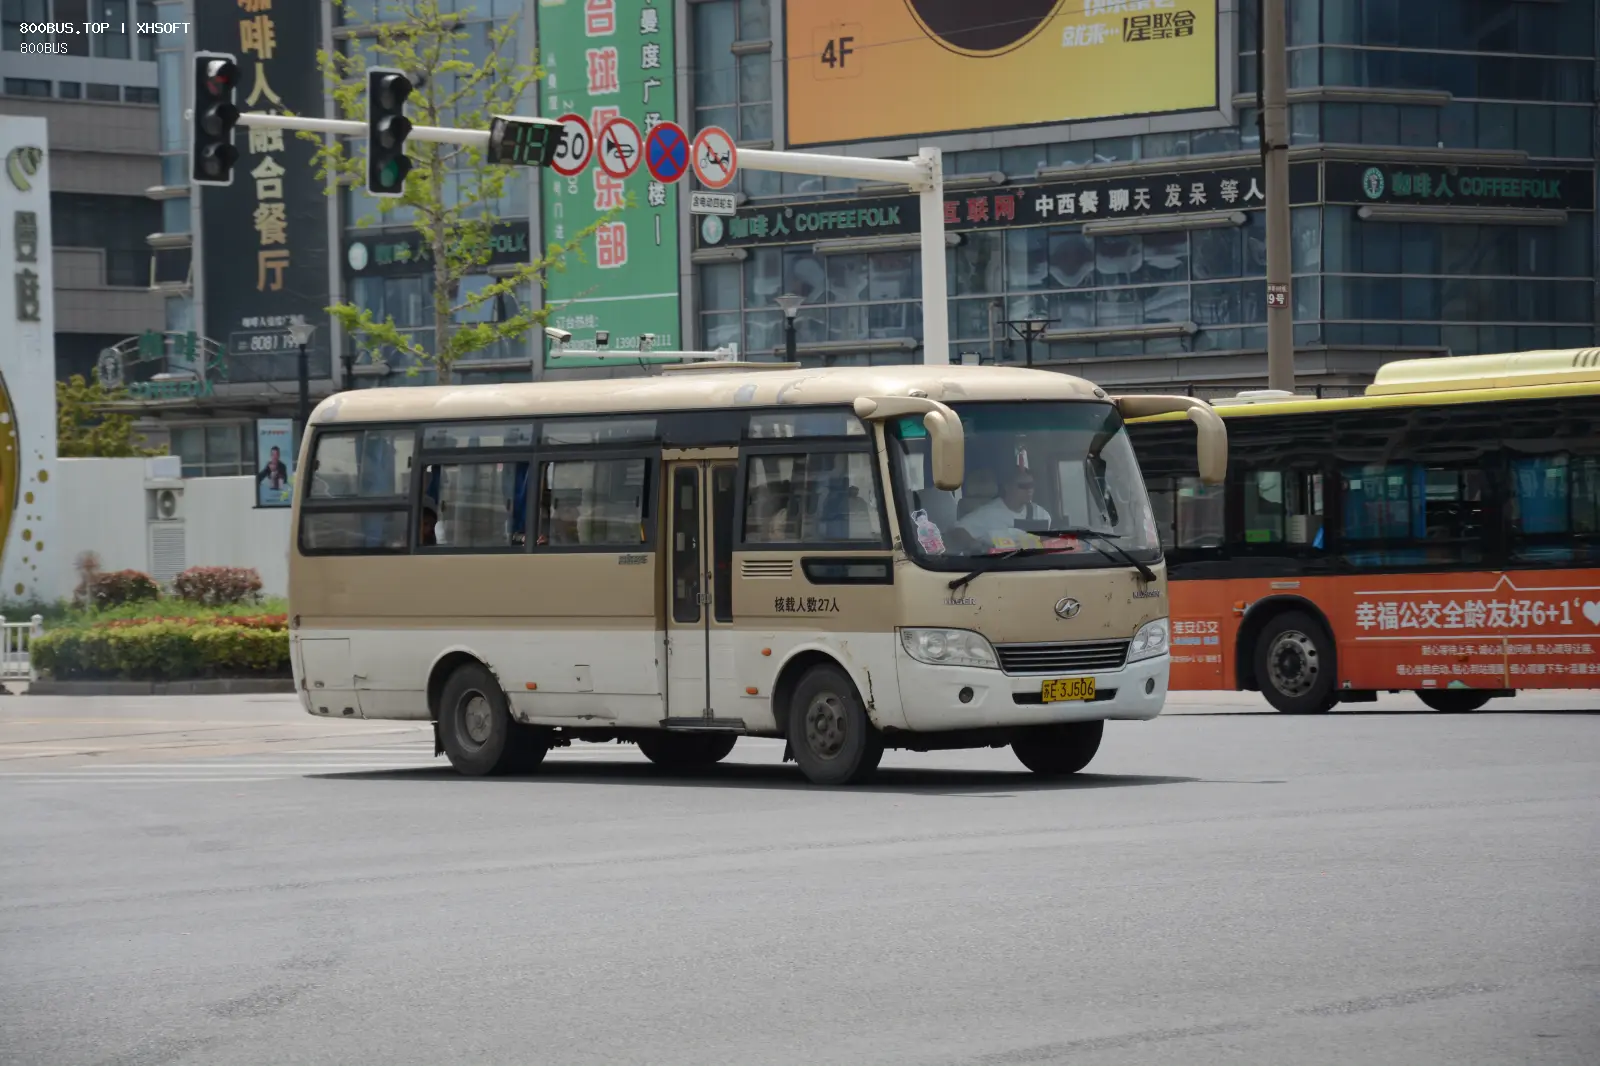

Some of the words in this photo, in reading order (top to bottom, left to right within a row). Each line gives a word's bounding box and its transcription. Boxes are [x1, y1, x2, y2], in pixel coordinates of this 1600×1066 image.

[821, 37, 854, 69] 4F
[237, 0, 290, 292] 啡人融合餐厅
[555, 132, 584, 160] 50
[1034, 190, 1099, 217] 中西餐
[1108, 188, 1151, 211] 聊天
[1165, 182, 1208, 207] 发呆
[1220, 178, 1266, 203] 等人
[1390, 172, 1455, 198] 咖啡人
[1460, 176, 1562, 199] COFFEEFOLK
[728, 212, 790, 239] 咖啡人
[795, 206, 900, 232] COFFEEFOLK
[775, 596, 840, 613] 核载人数27人
